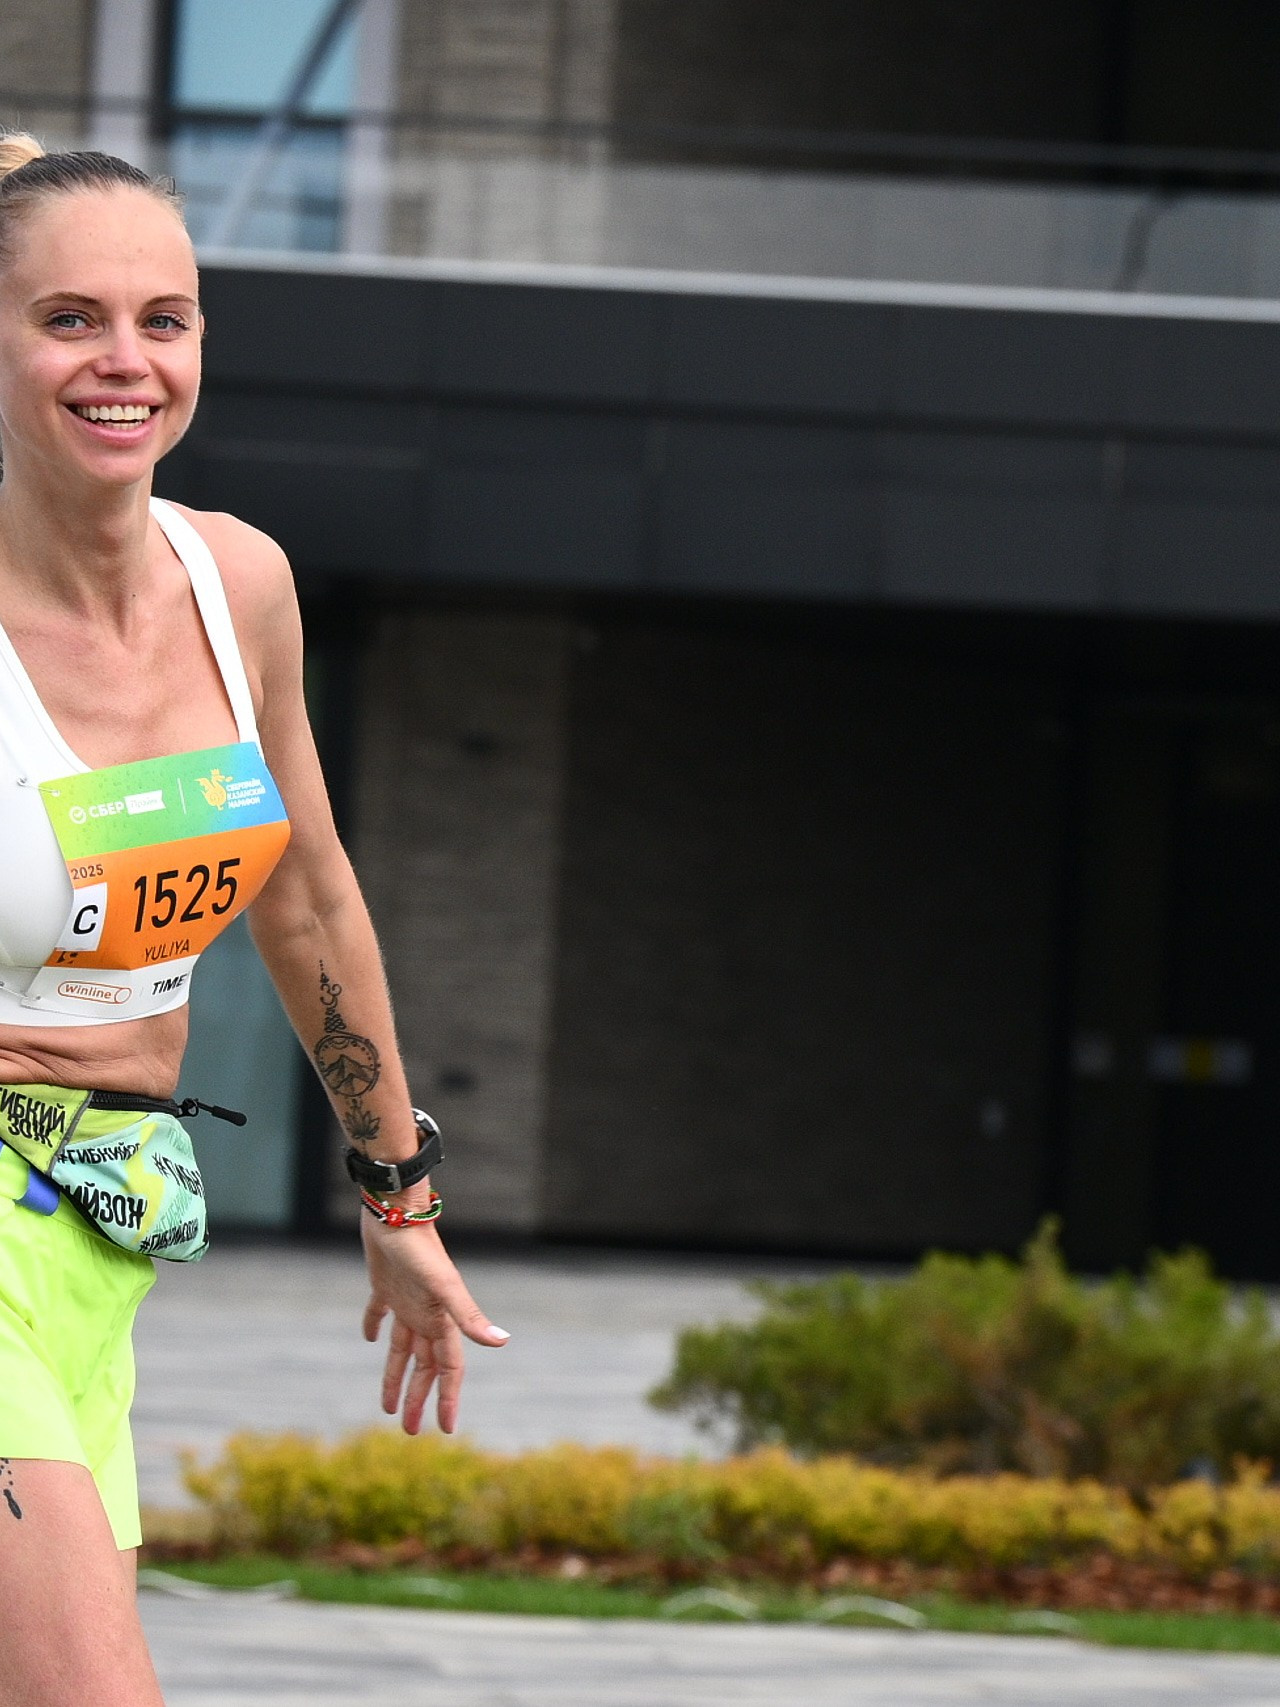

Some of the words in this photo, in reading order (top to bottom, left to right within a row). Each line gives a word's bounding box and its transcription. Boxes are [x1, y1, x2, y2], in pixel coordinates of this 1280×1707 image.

[70, 863, 104, 880] 2025
[134, 857, 240, 933] 1525
[144, 938, 190, 962] YULIYA
[65, 984, 112, 1000] Winline
